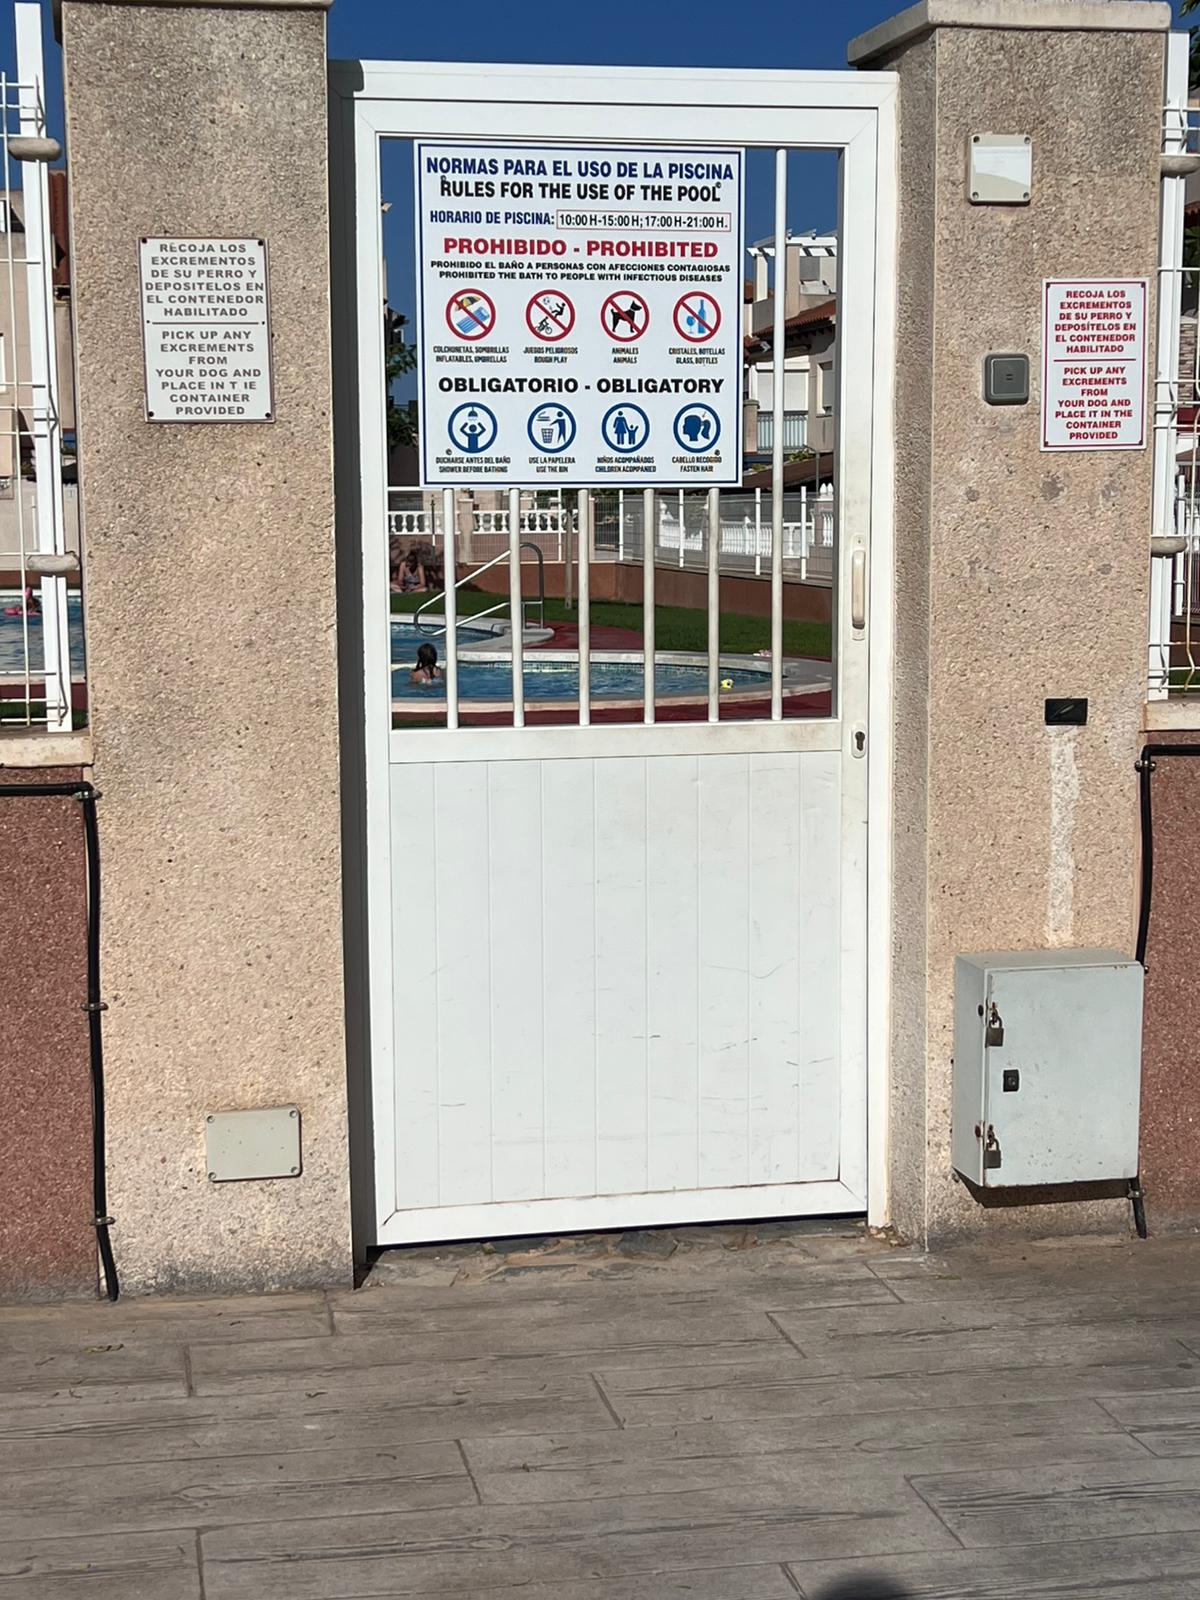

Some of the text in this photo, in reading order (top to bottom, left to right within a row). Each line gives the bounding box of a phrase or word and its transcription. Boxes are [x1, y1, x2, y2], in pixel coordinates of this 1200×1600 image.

[427, 157, 733, 180] NORMAS PARA EL USO DE LA PISCINA
[440, 180, 721, 201] RULES FOR THE USE OF THE POOL
[430, 210, 482, 224] HORARIO
[486, 212, 501, 224] DE
[504, 212, 555, 225] PISCINA:
[560, 214, 587, 226] 10:00
[645, 216, 672, 227] 17:00
[160, 243, 246, 252] RECOJA LOS
[444, 238, 567, 255] PROHIBIDO
[587, 240, 718, 257] PROHIBITED
[151, 257, 256, 265] EXCREMENTOS
[499, 260, 524, 269] BAÑO
[535, 262, 584, 270] PERSONAS
[608, 263, 665, 271] AFECCIONES
[667, 264, 731, 272] CONTAGIOSAS
[151, 270, 257, 278] DE SU PERRO Y
[440, 271, 495, 279] PROHIBITED
[145, 282, 264, 291] DEPOSITELOS EN
[1066, 290, 1126, 298] RECOJA LOS
[147, 295, 264, 303] EL CONTENEDOR
[164, 308, 248, 316] HABILITADO
[1059, 312, 1132, 320] DE SU PERRO Y
[1055, 322, 1136, 331] DEPOSÍTELOS EN
[162, 331, 251, 339] PICK UP ANY
[1070, 334, 1136, 342] CONTENEDOR
[160, 344, 254, 352] EXCREMENTS
[612, 347, 639, 355] ANIMALES
[1066, 345, 1124, 353] HABILITADO
[189, 356, 228, 364] FROM
[156, 369, 261, 377] YOUR DOG AND
[1064, 366, 1125, 375] PICK UP ANY
[161, 381, 205, 390] PLACE
[210, 382, 225, 390] IN
[438, 377, 579, 392] OBLIGATORIO
[596, 378, 725, 393] OBLIGATORY
[1062, 377, 1127, 386] EXCREMENTS
[170, 394, 250, 402] CONTAINER
[1087, 399, 1108, 407] DOG
[1111, 399, 1131, 407] AND
[176, 406, 245, 415] PROVIDED
[1055, 410, 1086, 418] PLACE
[1089, 410, 1098, 418] IT
[1101, 410, 1111, 418] IN
[1066, 421, 1121, 429] CONTAINER
[1069, 432, 1118, 440] PROVIDED
